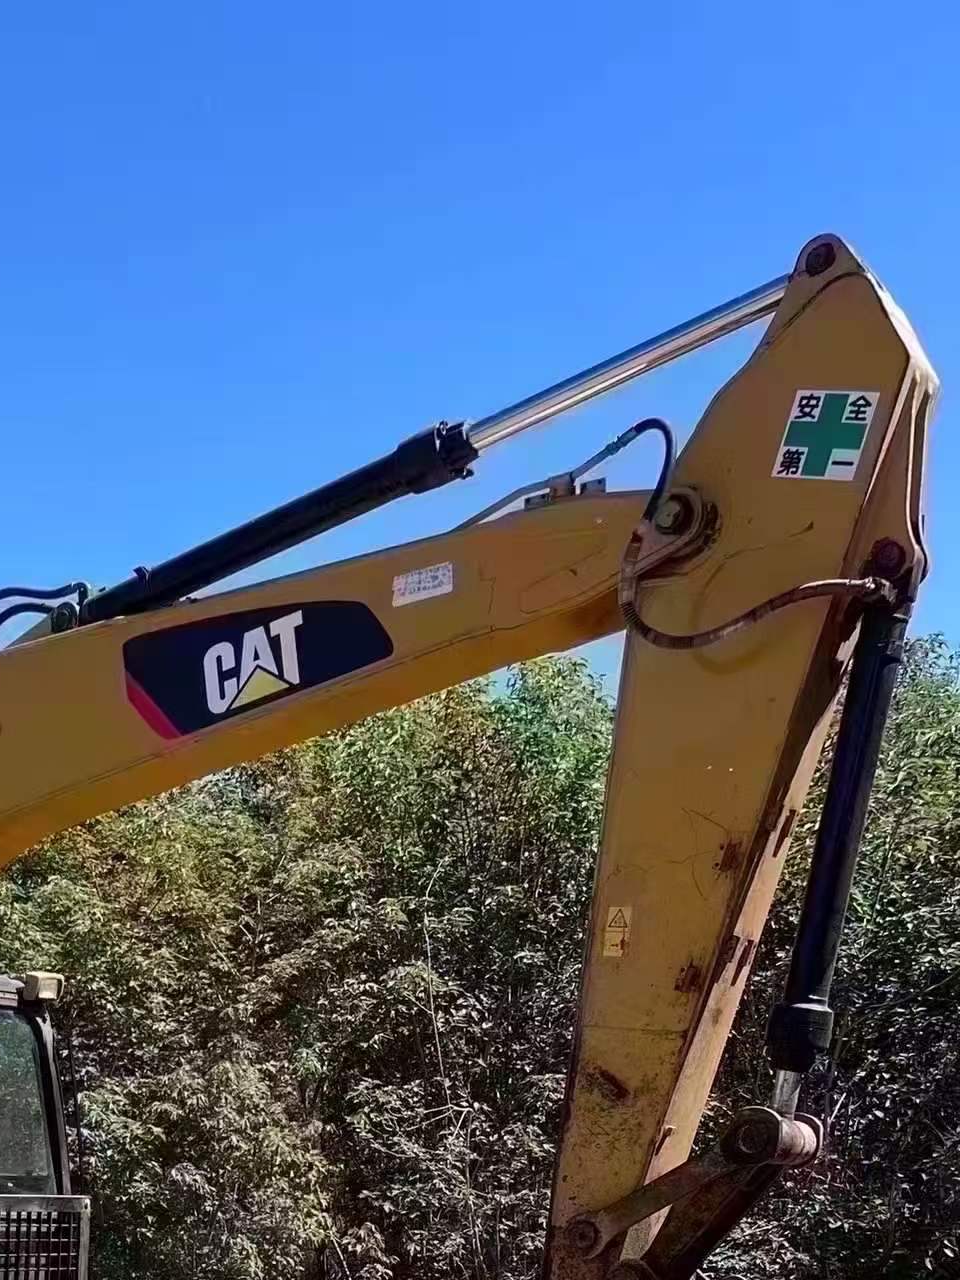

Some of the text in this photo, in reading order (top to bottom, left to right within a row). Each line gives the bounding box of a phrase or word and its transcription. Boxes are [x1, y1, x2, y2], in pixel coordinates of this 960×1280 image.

[794, 393, 872, 422] 安全
[776, 447, 855, 476] 第一
[203, 610, 304, 715] CAT
